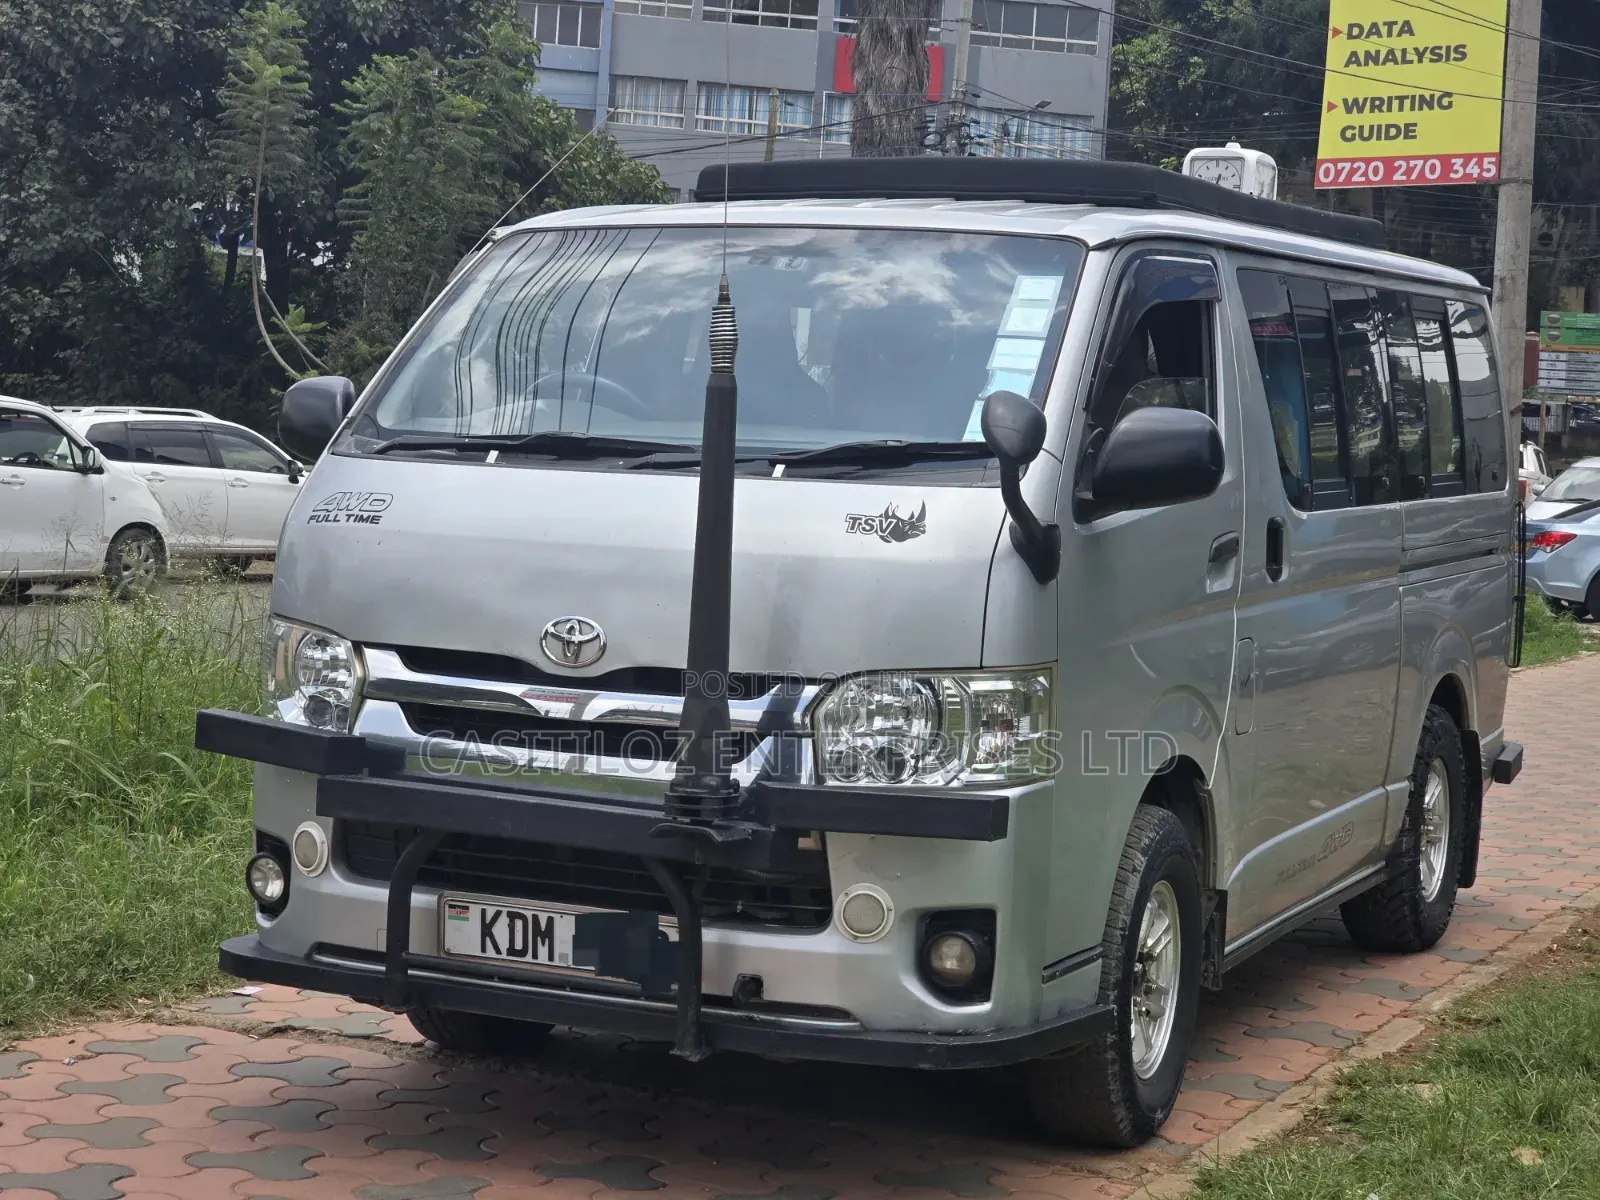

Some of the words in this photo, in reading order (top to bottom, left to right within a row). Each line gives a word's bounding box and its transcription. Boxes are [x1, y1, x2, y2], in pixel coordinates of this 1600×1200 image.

[1346, 19, 1416, 40] DATA
[1343, 43, 1468, 68] ANALYSIS
[1341, 92, 1454, 115] WRITING
[1339, 122, 1418, 143] GUIDE
[1318, 162, 1384, 183] 0720
[1392, 159, 1441, 181] 270
[1449, 157, 1497, 178] 345
[312, 491, 394, 513] 4WD
[306, 513, 341, 525] FULL
[344, 513, 383, 525] TIME
[845, 513, 897, 536] TSV
[480, 907, 555, 962] KDM
